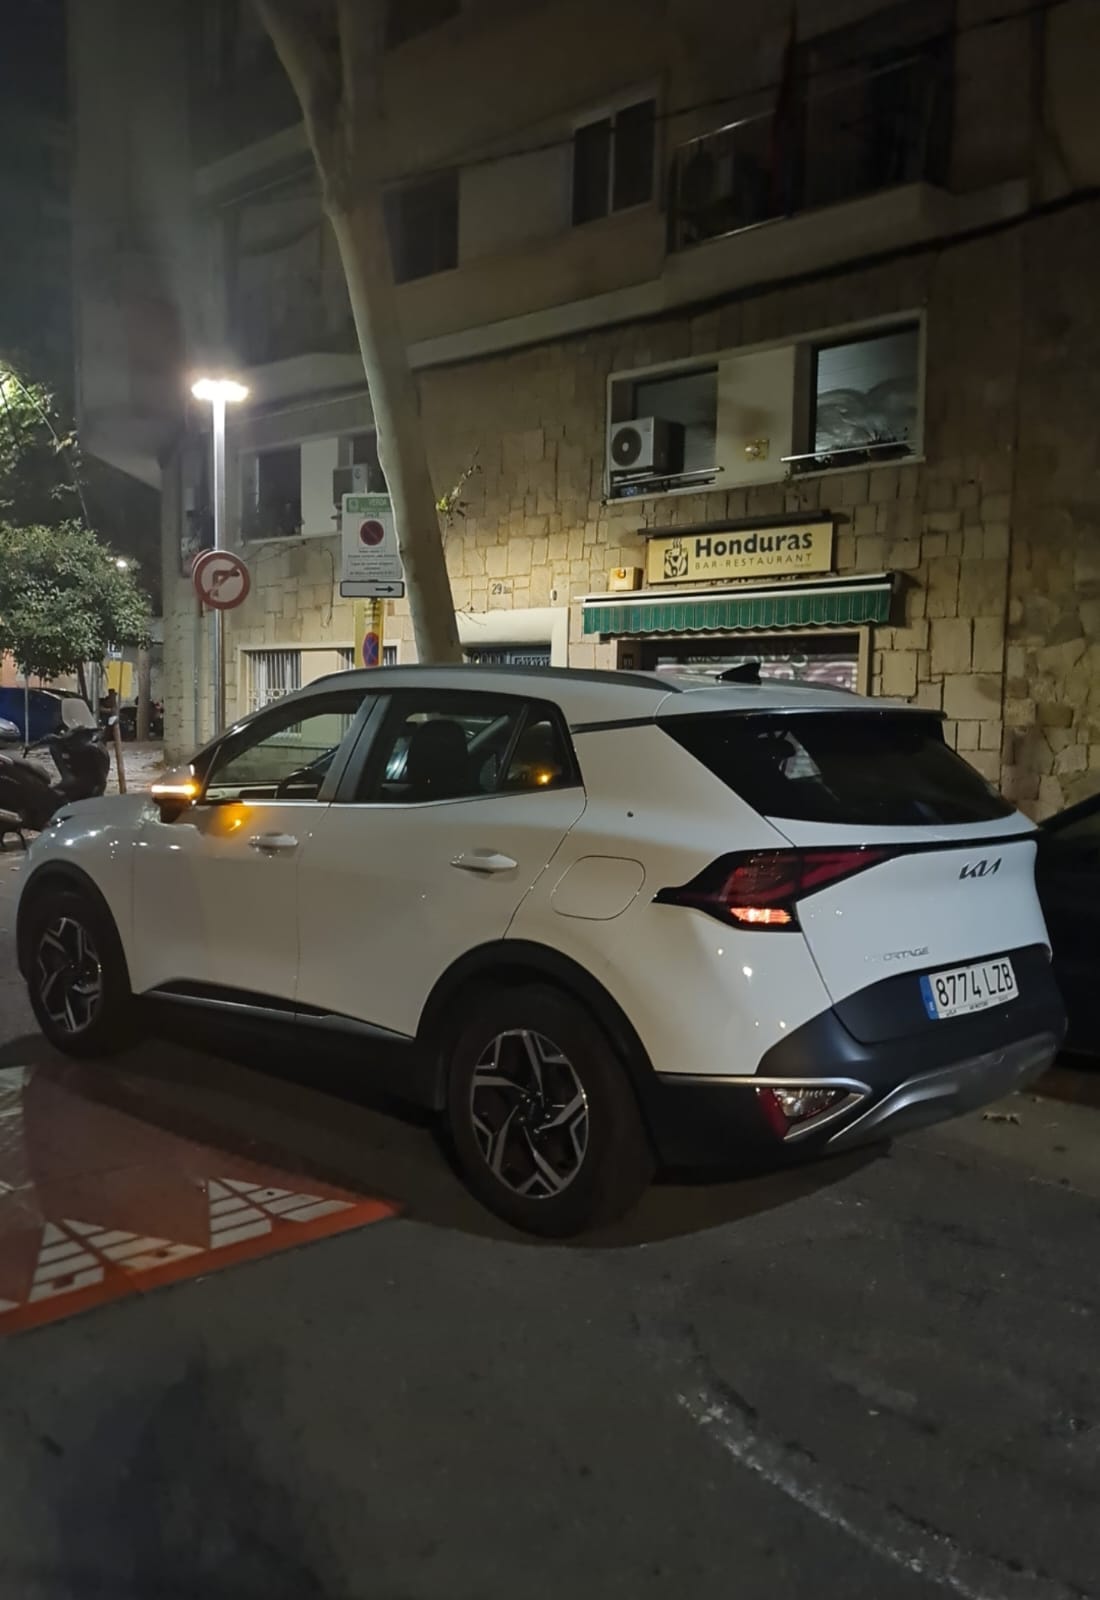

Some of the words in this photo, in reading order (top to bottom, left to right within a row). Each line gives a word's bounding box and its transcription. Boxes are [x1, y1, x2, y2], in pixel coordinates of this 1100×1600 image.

[695, 532, 813, 559] Honduras
[695, 553, 813, 570] BAR-RESTAURANT
[958, 857, 1002, 880] KIA
[936, 970, 982, 1007] 8774
[983, 963, 1014, 995] LZB
